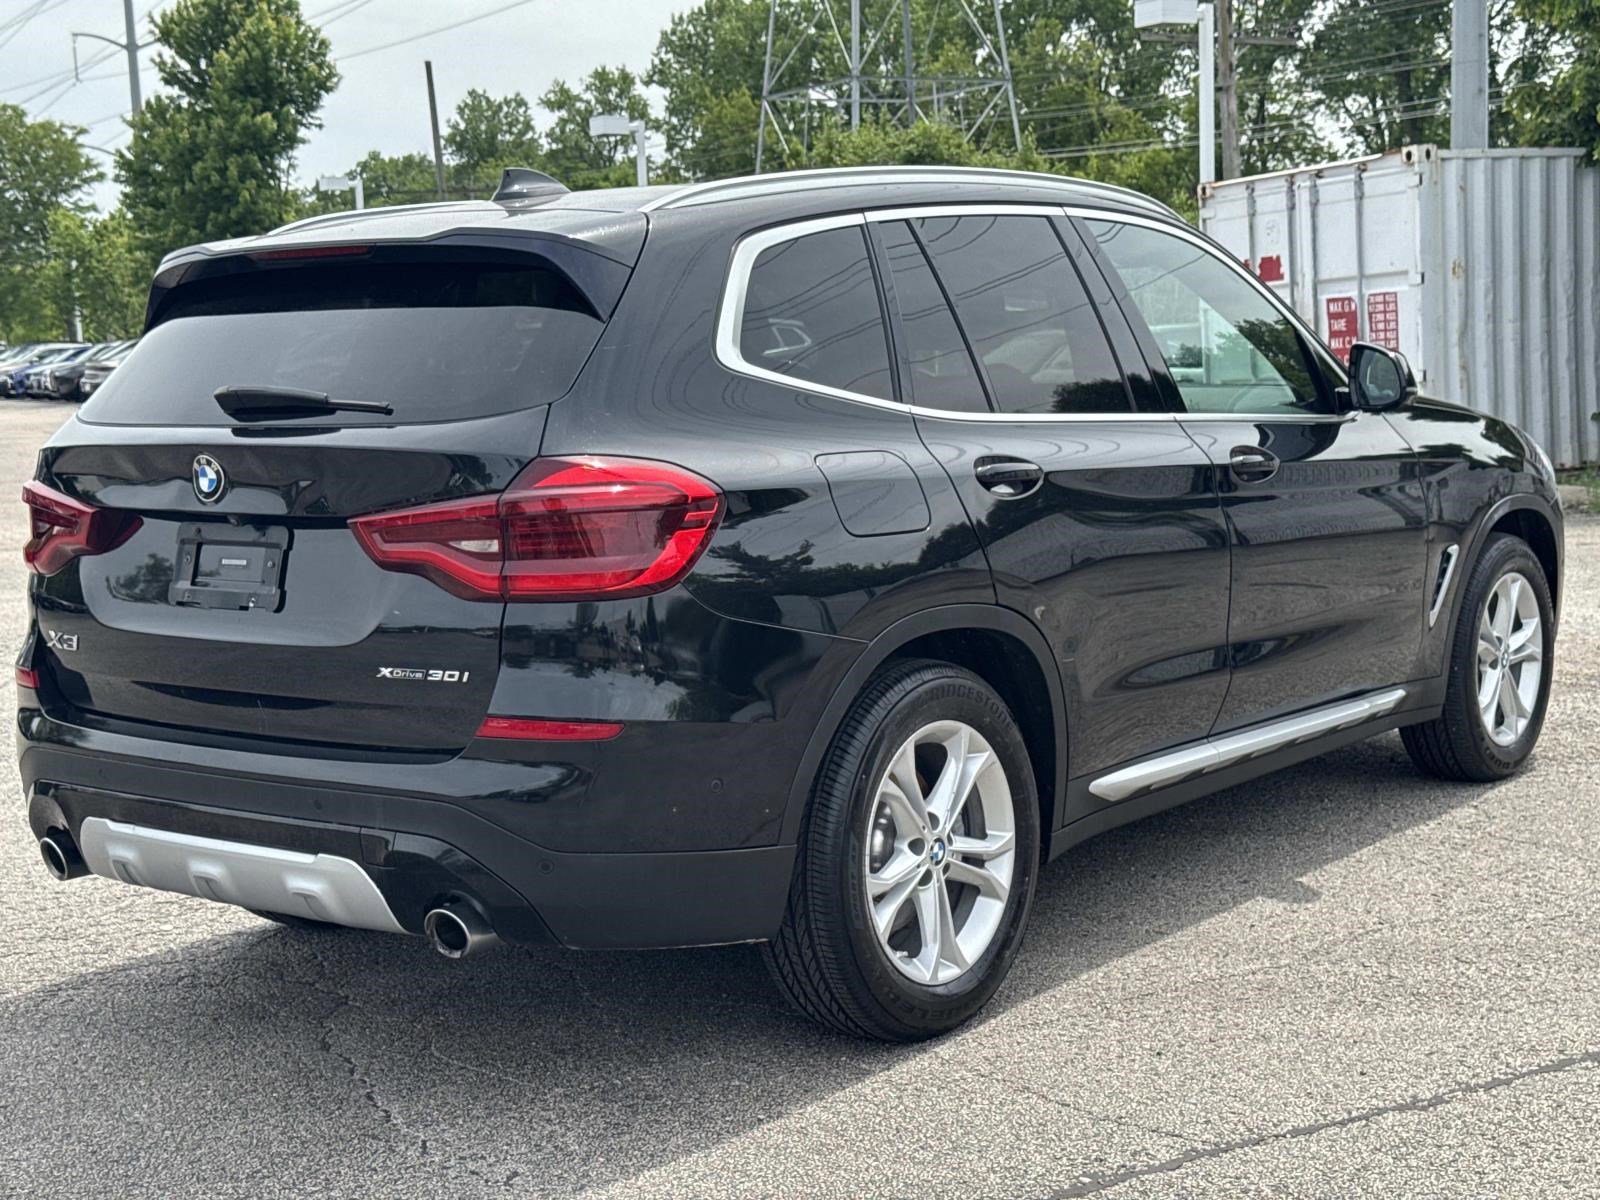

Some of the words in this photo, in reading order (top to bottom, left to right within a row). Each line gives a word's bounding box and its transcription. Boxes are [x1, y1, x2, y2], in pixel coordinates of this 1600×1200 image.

[1329, 301, 1343, 313] MAX
[1330, 318, 1347, 331] TARE
[1331, 337, 1344, 349] MAX
[47, 629, 78, 651] X3
